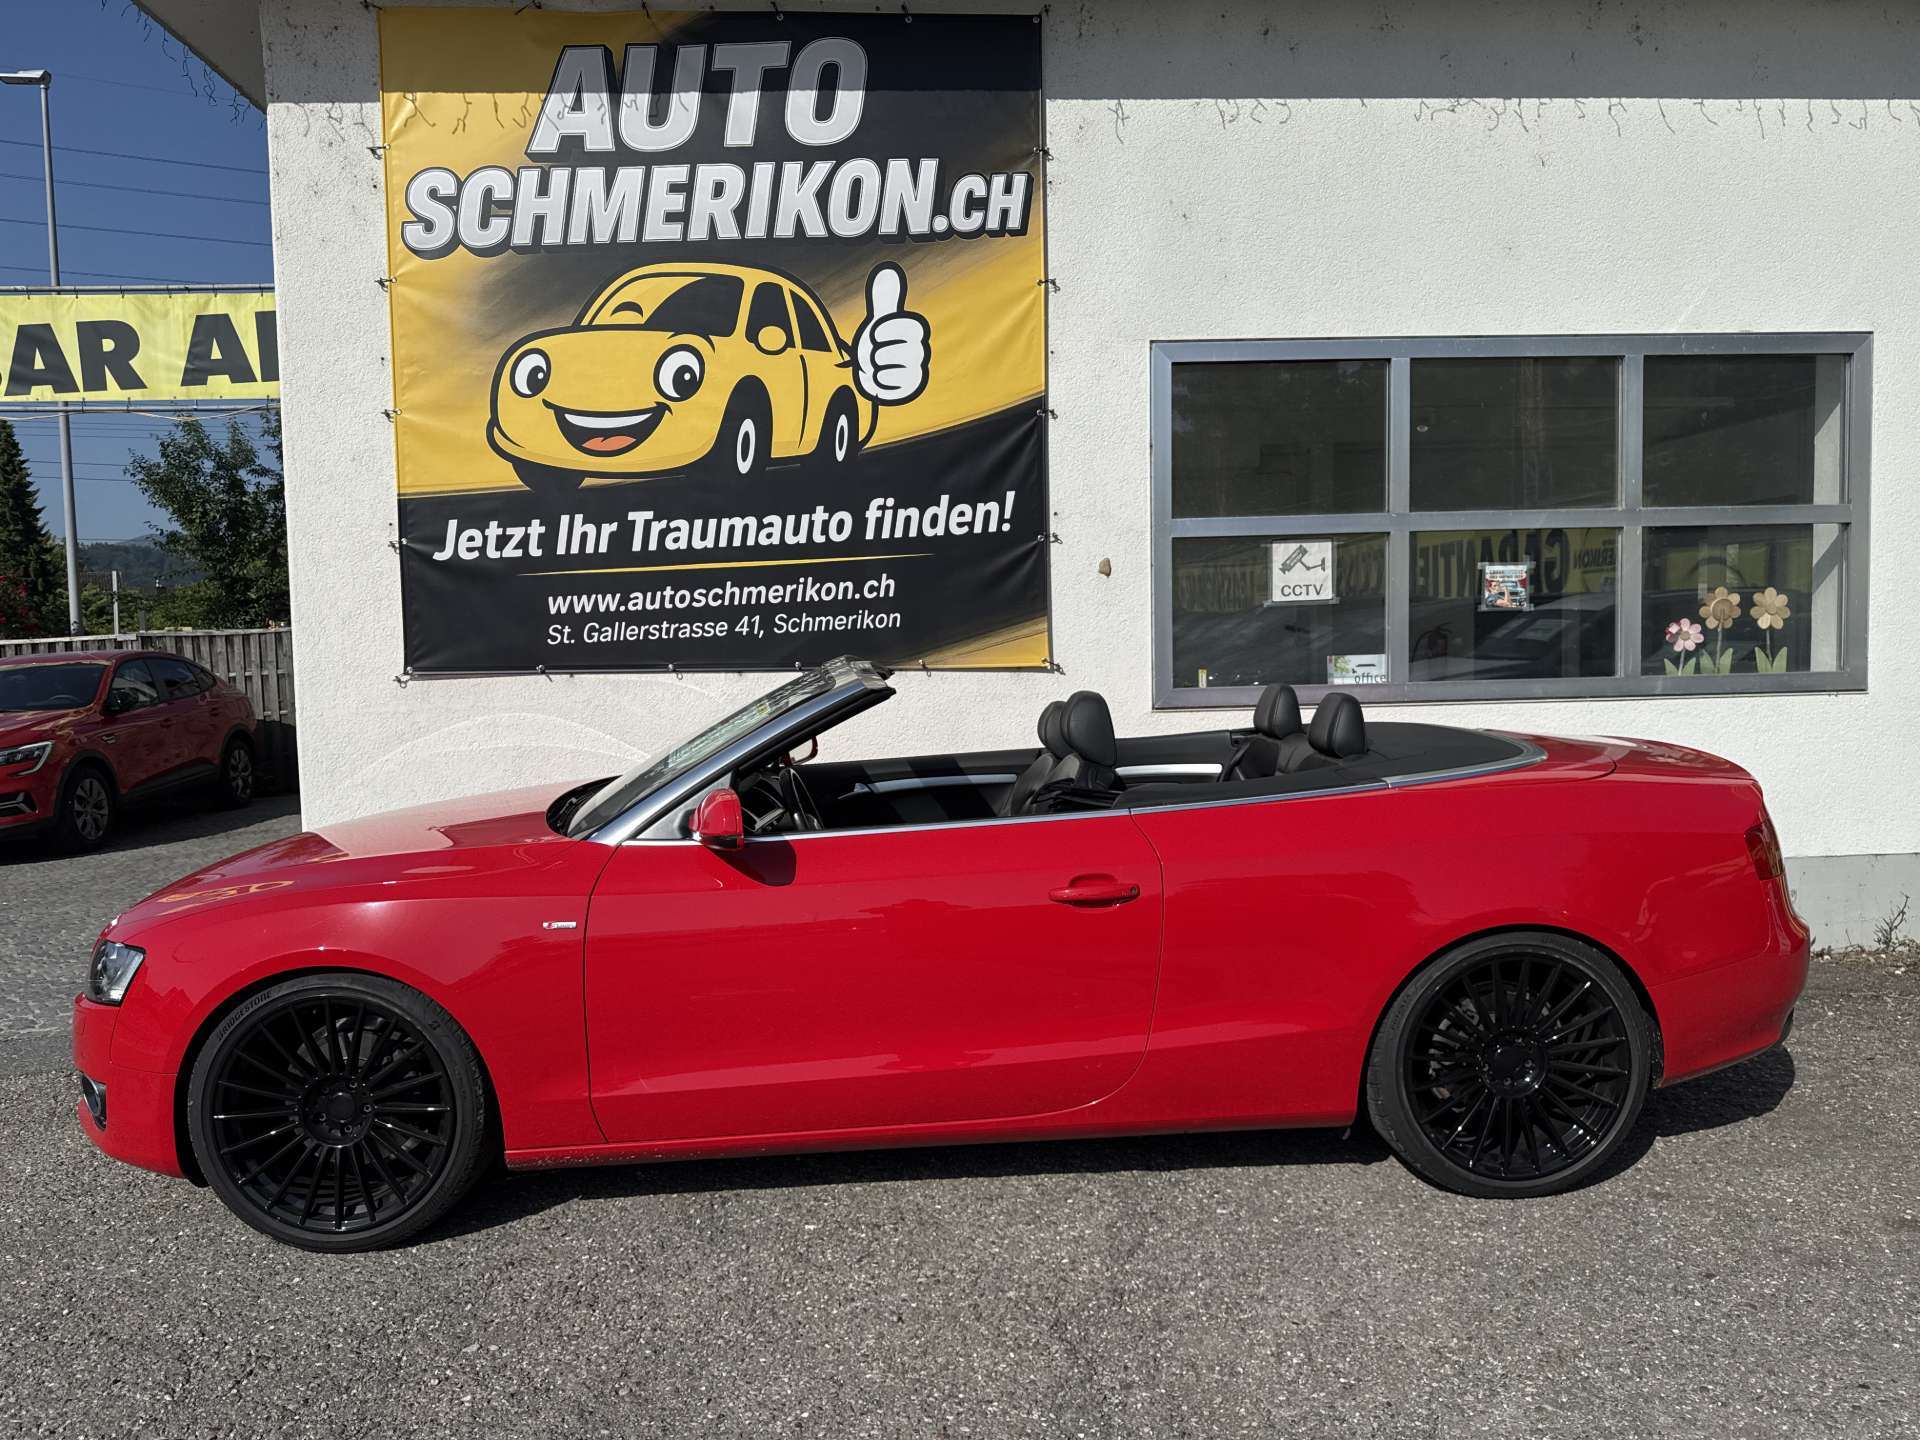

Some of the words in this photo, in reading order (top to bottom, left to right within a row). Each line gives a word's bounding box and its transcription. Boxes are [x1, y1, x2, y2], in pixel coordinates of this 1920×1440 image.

[526, 37, 868, 153] AUTO
[402, 157, 1029, 252] SCHMERIKON.CH
[0, 319, 148, 397] AR
[432, 518, 546, 561] Jetzt
[556, 513, 619, 555] Ihr
[627, 505, 853, 552] Traumauto
[865, 490, 1016, 540] finden!
[548, 573, 895, 615] www.autoschmerikon.ch
[1280, 583, 1323, 597] CCTV
[546, 624, 575, 645] St.
[583, 620, 729, 644] Gallerstrasse
[734, 614, 764, 639] 41,
[773, 609, 901, 634] Schmerikon
[1354, 672, 1386, 684] office
